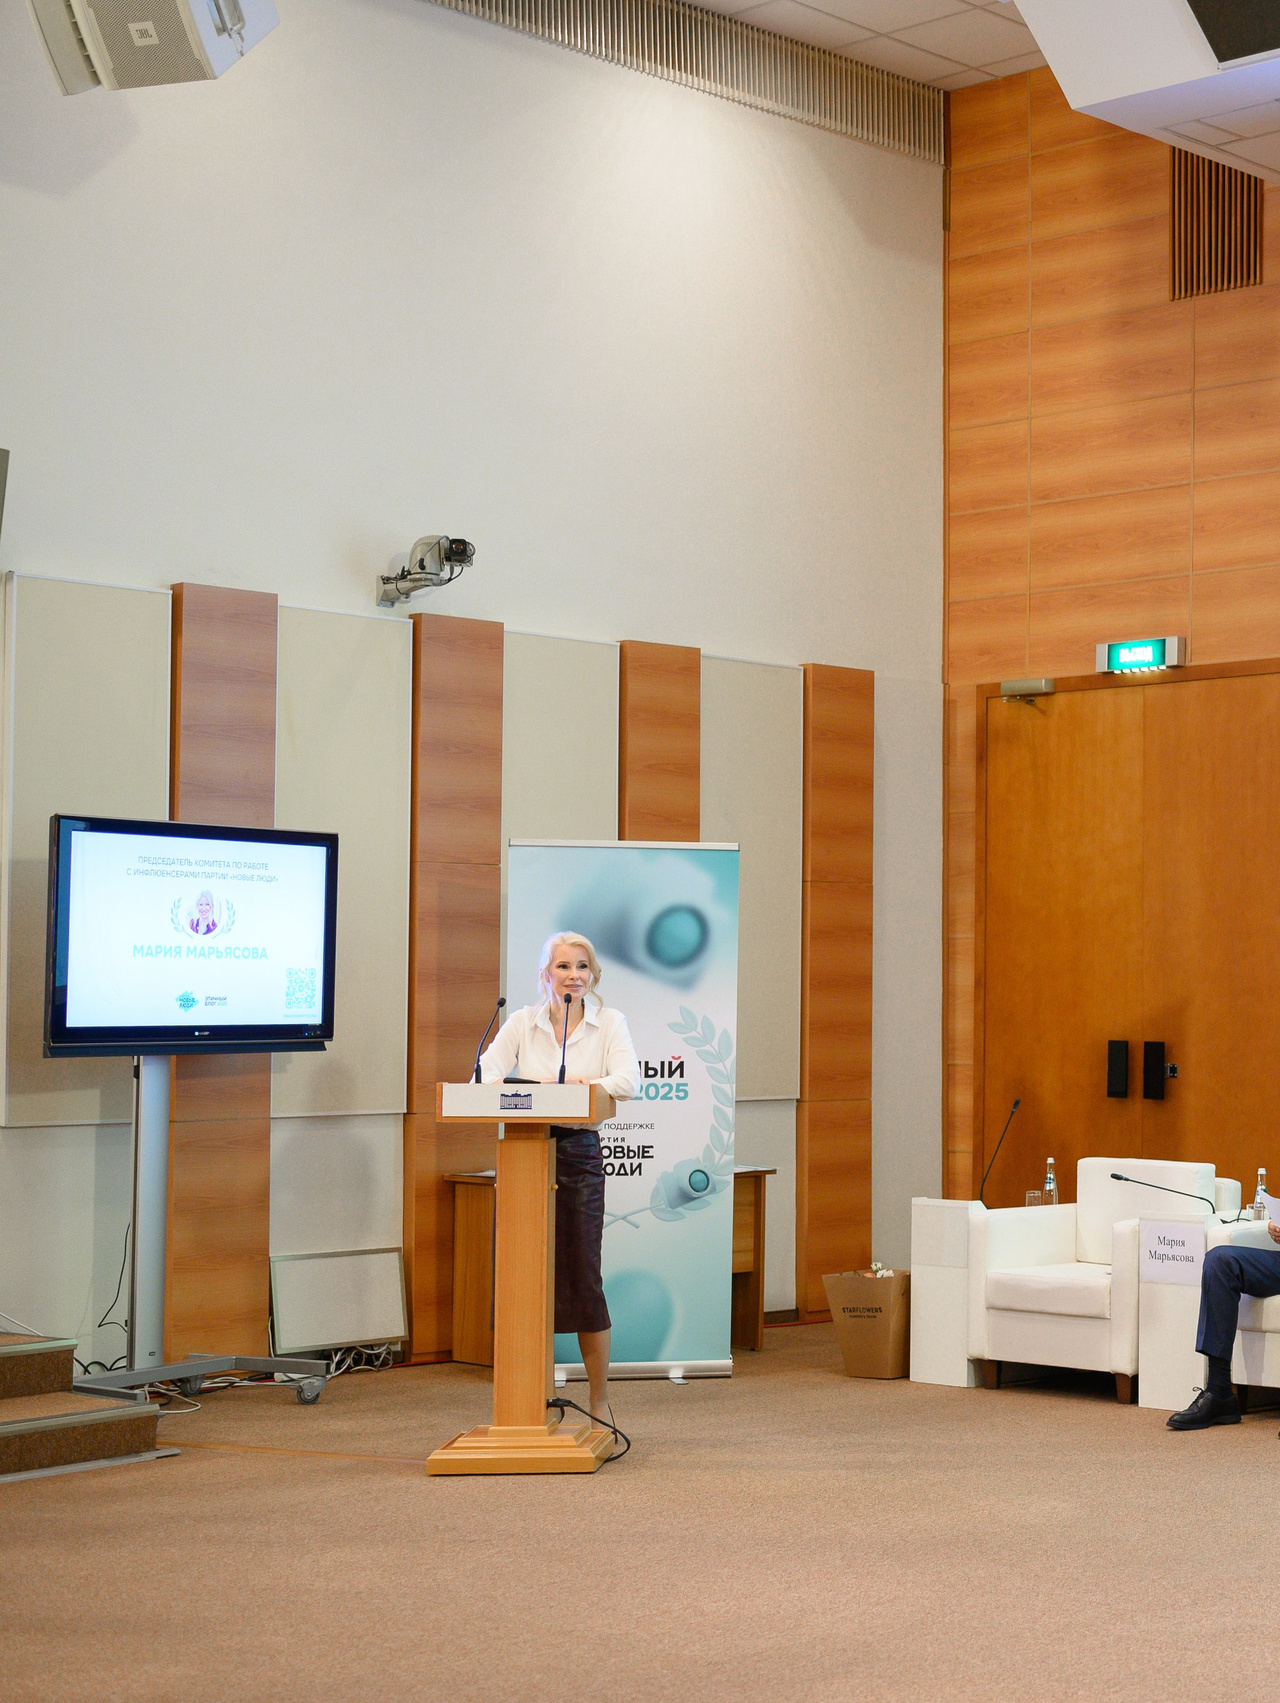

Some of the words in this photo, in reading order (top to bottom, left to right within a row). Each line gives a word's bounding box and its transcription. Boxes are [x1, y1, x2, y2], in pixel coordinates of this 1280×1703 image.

[138, 856, 193, 866] ПРЕДСЕДАТЕЛЬ
[194, 860, 231, 868] КОМИТЕТА
[232, 861, 242, 869] ПО
[244, 862, 269, 870] РАБОТЕ
[133, 868, 199, 879] ИНФЛЮЕНСЕРАМИ
[201, 871, 228, 880] ПАРТИИ
[133, 944, 182, 958] МАРИЯ
[186, 946, 268, 960] МАРЬЯСОВА
[638, 1055, 685, 1079] ЫЙ
[604, 1123, 655, 1131] ПОДДЕРЖКЕ
[601, 1145, 654, 1159] ОВЫЕ
[602, 1162, 642, 1176] ЮДИ
[1157, 1235, 1186, 1249] Мария
[1148, 1249, 1195, 1263] Марьясова
